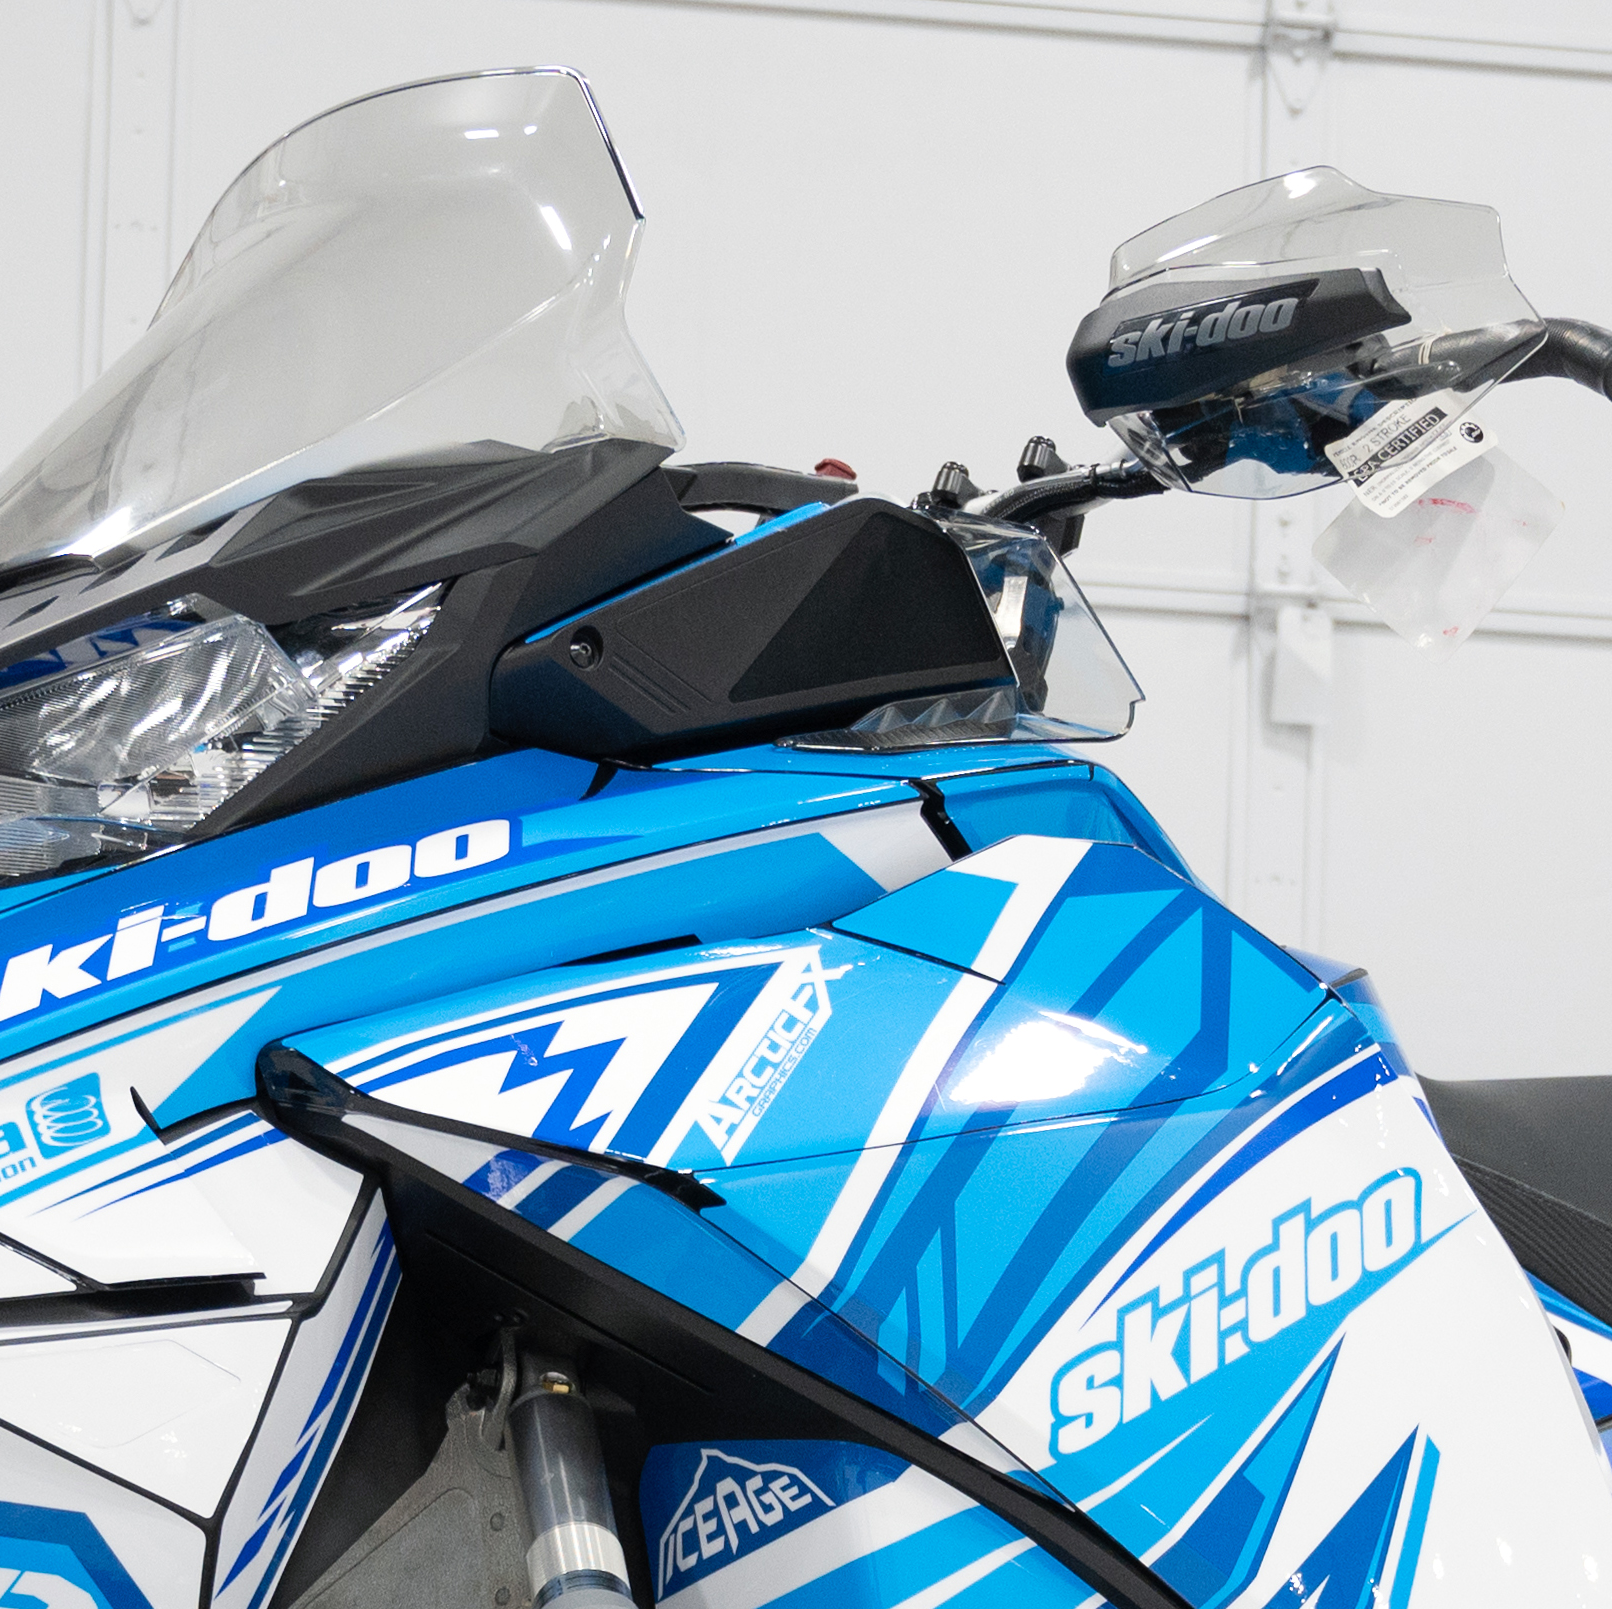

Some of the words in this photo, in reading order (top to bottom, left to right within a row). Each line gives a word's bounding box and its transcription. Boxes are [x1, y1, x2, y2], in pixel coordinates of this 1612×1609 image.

[1107, 297, 1299, 368] ski-doo
[1353, 463, 1382, 483] EPA
[1378, 413, 1440, 461] CERTIFIED
[1371, 413, 1411, 447] STROKE
[1051, 1168, 1422, 1457] ski-doo
